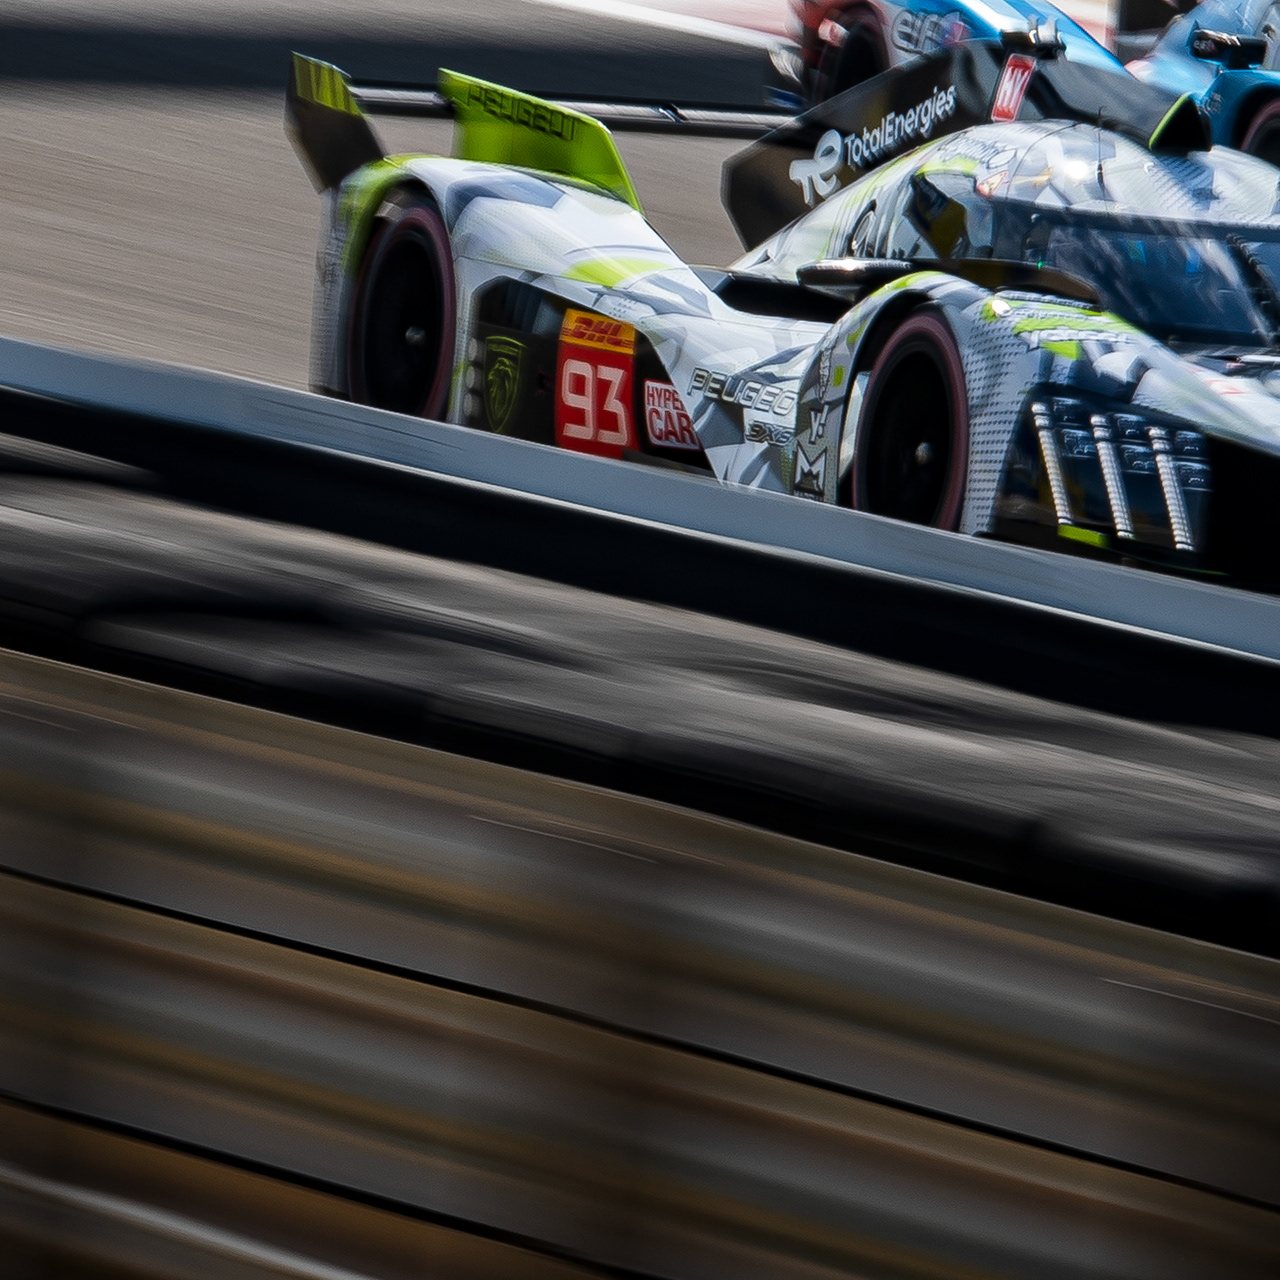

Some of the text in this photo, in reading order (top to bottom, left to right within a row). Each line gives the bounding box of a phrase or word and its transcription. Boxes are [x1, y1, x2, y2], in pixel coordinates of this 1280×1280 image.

[996, 66, 1028, 110] HY
[468, 85, 582, 141] PEUGEOT
[844, 85, 957, 170] TotalEnergies
[571, 316, 623, 347] DHL
[561, 358, 628, 446] 93
[646, 384, 686, 412] HYPE
[648, 406, 701, 448] CAR
